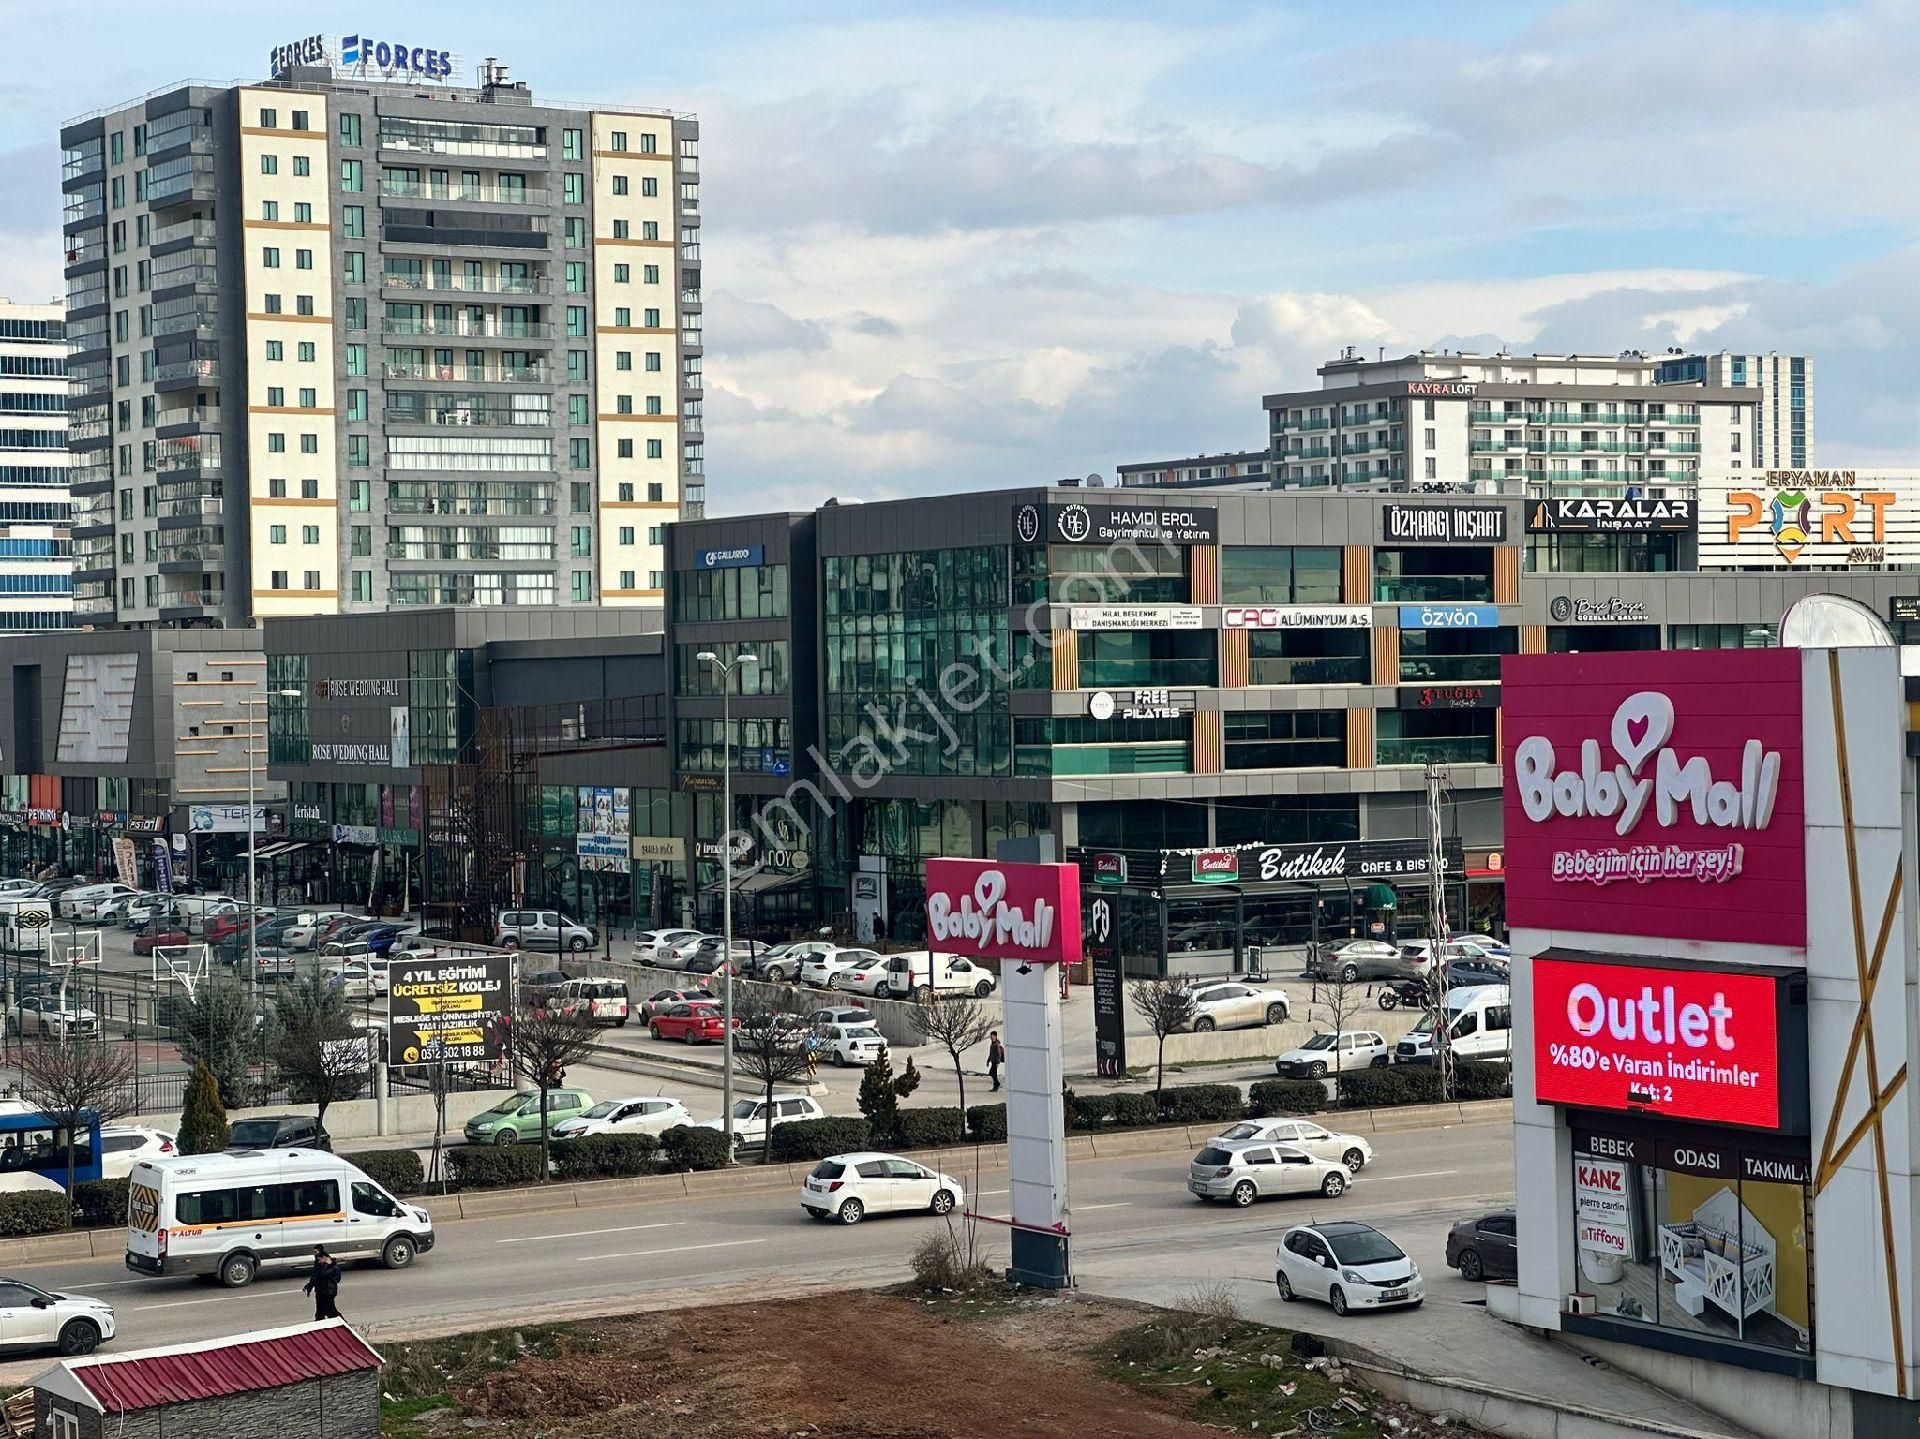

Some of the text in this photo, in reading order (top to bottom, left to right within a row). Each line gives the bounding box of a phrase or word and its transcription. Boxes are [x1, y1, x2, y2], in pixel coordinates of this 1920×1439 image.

[279, 34, 323, 72] FORCES
[361, 38, 452, 76] FORCES
[1408, 382, 1477, 394] KAYRA LOFT
[1766, 470, 1856, 487] ERYAMAN
[1559, 500, 1689, 518] KARALAR
[1110, 511, 1198, 526] HAMDİ EROL
[1597, 520, 1652, 529] İNŞAAT
[1099, 526, 1210, 539] Gayrimenkul ve Yatırım
[717, 549, 750, 560] GALLARDO
[1846, 547, 1885, 562] AVM
[1140, 619, 1169, 627] MERKEZİ
[1281, 613, 1347, 626] ALÜMİNYUM
[1351, 614, 1371, 627] A.Ş.
[349, 680, 381, 697] WEDDING
[381, 679, 399, 696] HALL
[1134, 690, 1168, 704] FREE
[1123, 708, 1180, 719] PILATES
[312, 744, 390, 760] ROSE WEDDING HALL
[1515, 736, 1781, 836] Baby Mall
[1259, 847, 1345, 880] Butikek
[1361, 862, 1391, 873] CAFE
[1396, 863, 1403, 871] &
[1553, 845, 1734, 879] Bebeğim için her şey!
[929, 891, 996, 949] Baby
[996, 896, 1054, 949] Mall
[404, 965, 487, 983] 4 YIL EĞİTİMİ
[393, 981, 458, 997] ÜCRETSİZ
[1567, 983, 1735, 1051] Outlet
[461, 1045, 471, 1057] 18
[472, 1045, 485, 1056] 88
[1550, 1043, 1760, 1089] %80'e Varan İndirimler
[1663, 1085, 1673, 1102] 2
[1591, 1136, 1634, 1158] BEBEK
[1674, 1149, 1720, 1169] ODASI
[1579, 1166, 1621, 1191] KANZ
[1580, 1196, 1625, 1212] pierre cardin
[179, 1229, 202, 1237] ALTUR
[1587, 1227, 1624, 1250] Tiffany
